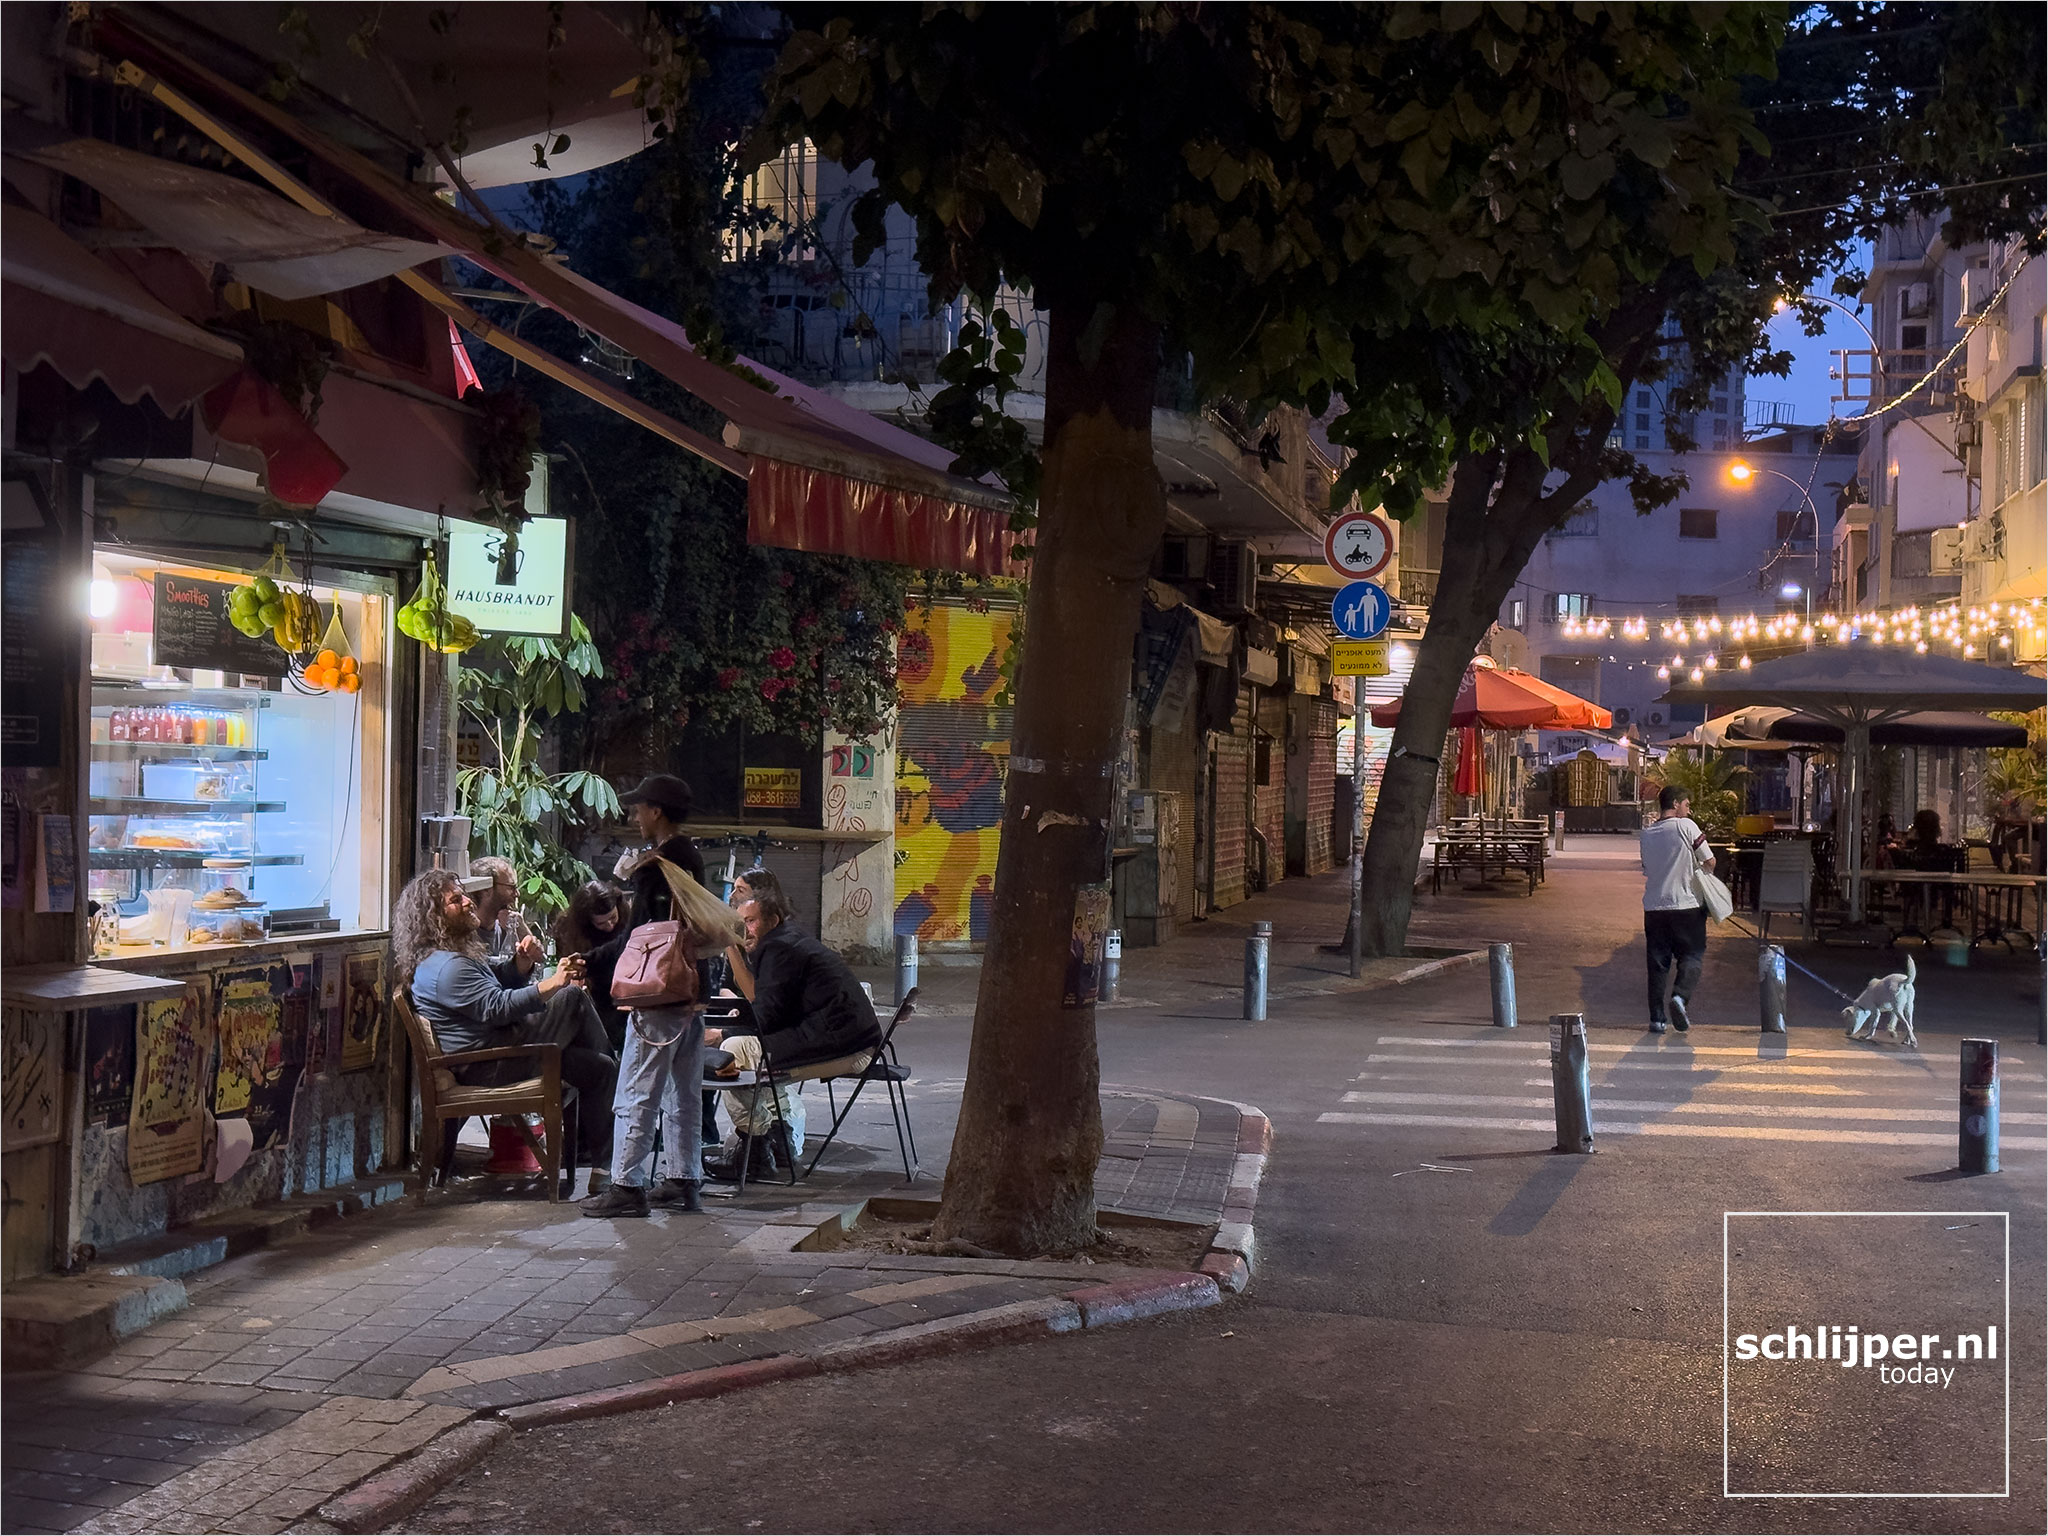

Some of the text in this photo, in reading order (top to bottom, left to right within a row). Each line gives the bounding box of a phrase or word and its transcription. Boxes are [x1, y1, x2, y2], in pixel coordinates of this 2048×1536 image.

[455, 589, 555, 607] HAUSBRANDT
[1365, 648, 1386, 656] למעט
[1372, 661, 1382, 669] לא
[746, 773, 799, 785] להשכרה
